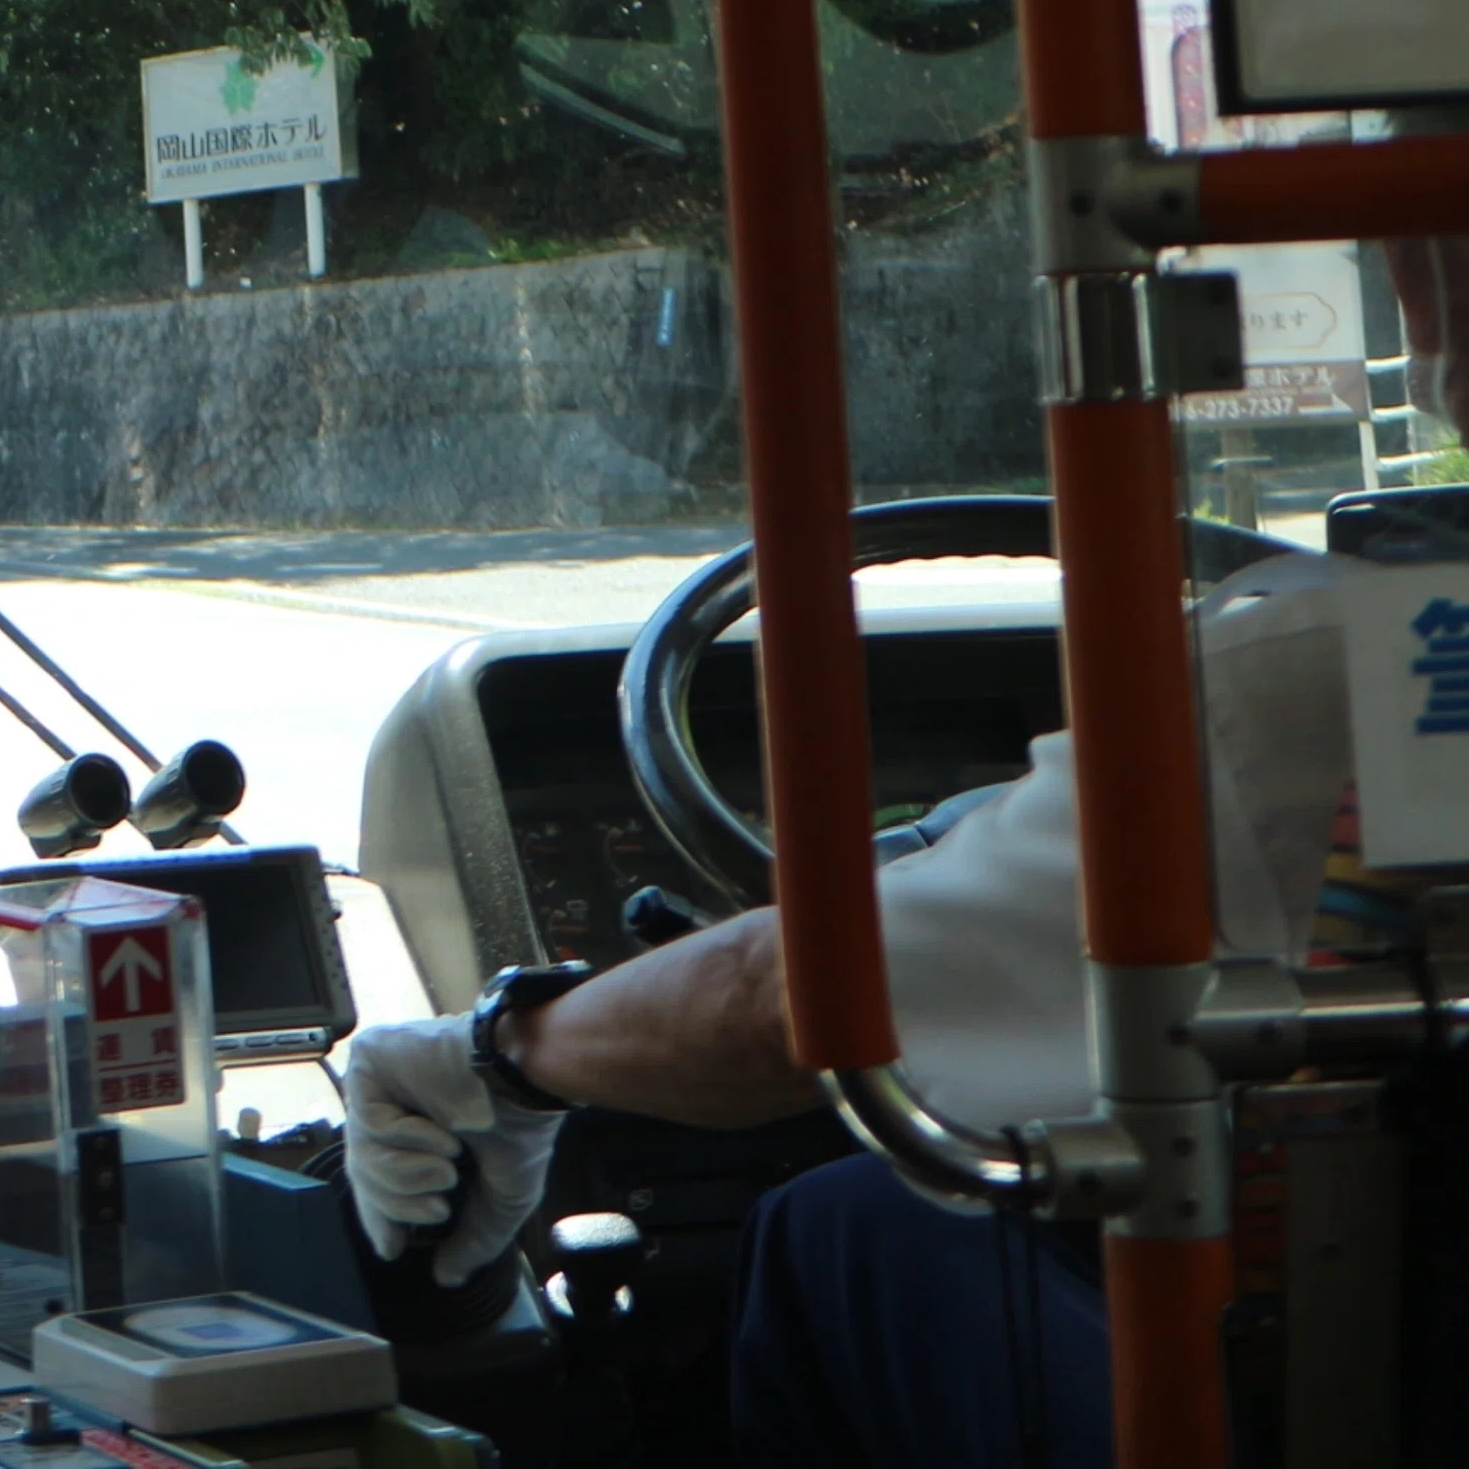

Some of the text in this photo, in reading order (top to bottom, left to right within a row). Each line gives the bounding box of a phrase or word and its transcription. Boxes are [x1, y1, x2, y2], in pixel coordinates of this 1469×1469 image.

[156, 113, 328, 164] 岡山国際ホテル
